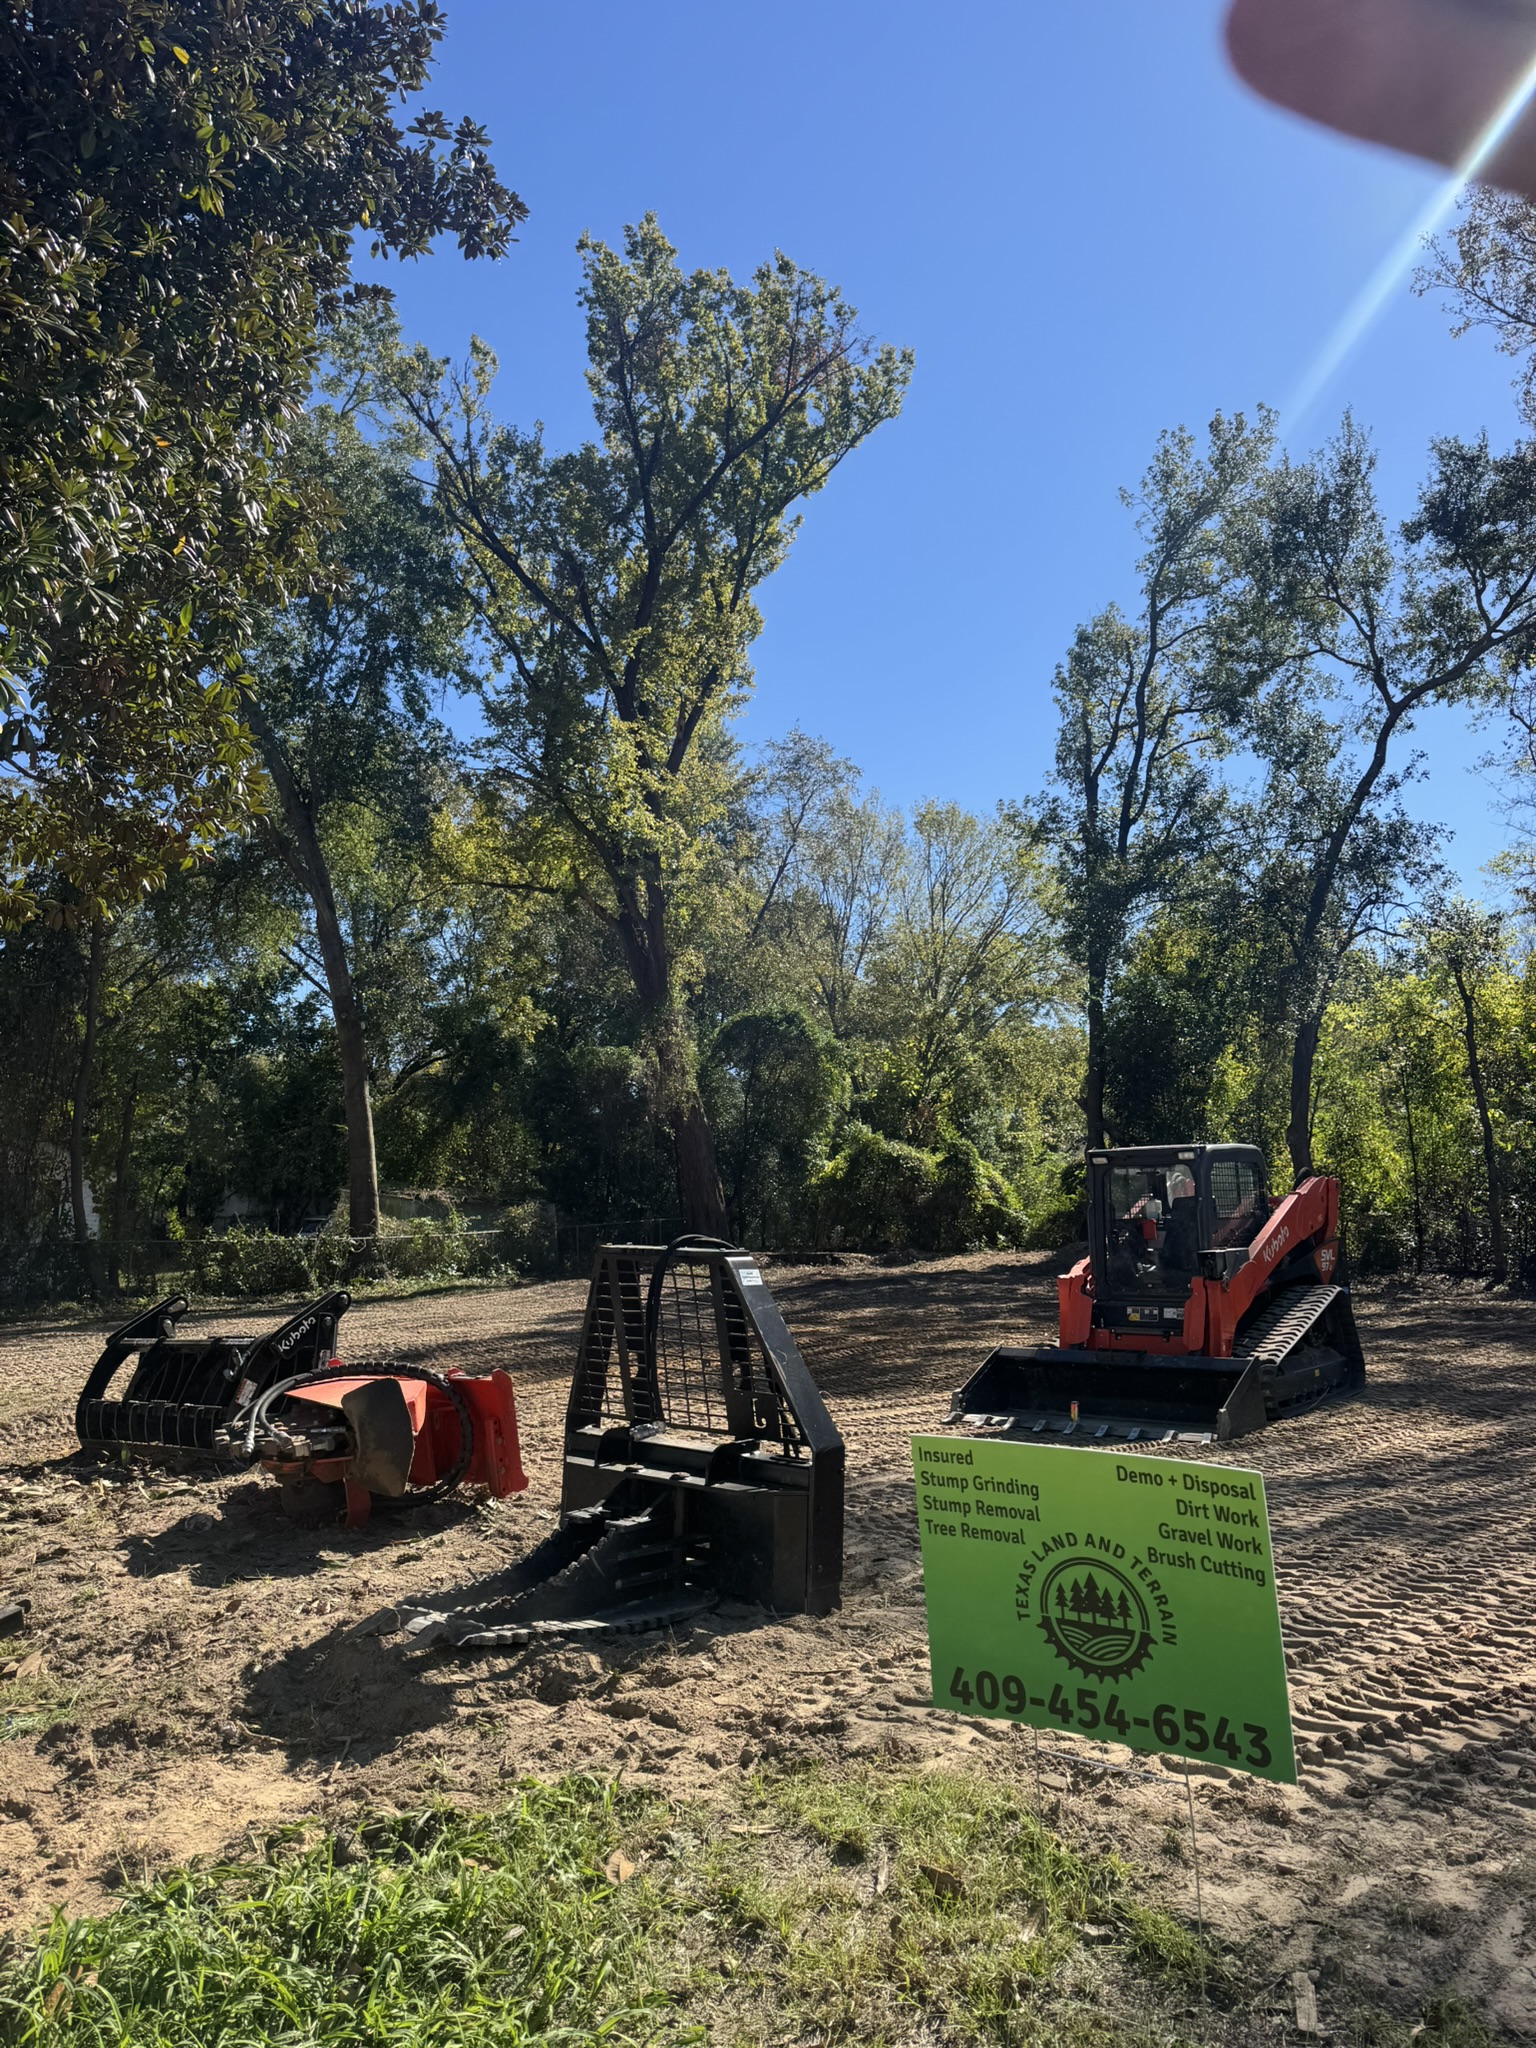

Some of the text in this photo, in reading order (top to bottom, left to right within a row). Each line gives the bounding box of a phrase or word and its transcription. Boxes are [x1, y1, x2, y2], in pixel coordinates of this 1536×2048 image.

[1262, 1225, 1290, 1262] Kubota
[1321, 1249, 1336, 1261] SVL
[278, 1316, 316, 1352] Kubota
[918, 1446, 974, 1466] Insured
[920, 1470, 1040, 1501] Stump Grinding
[1116, 1465, 1257, 1501] Demo + Disposal
[923, 1494, 1041, 1522] Stump Removal
[1176, 1498, 1260, 1528] Dirt Work
[924, 1518, 1026, 1545] Tree Removal
[1158, 1522, 1263, 1556] Gravel Work
[1147, 1546, 1266, 1588] Brush Cutting
[1016, 1532, 1178, 1646] TEXAS LAND AND TERRAIN
[949, 1666, 1272, 1768] 409-454-6543
